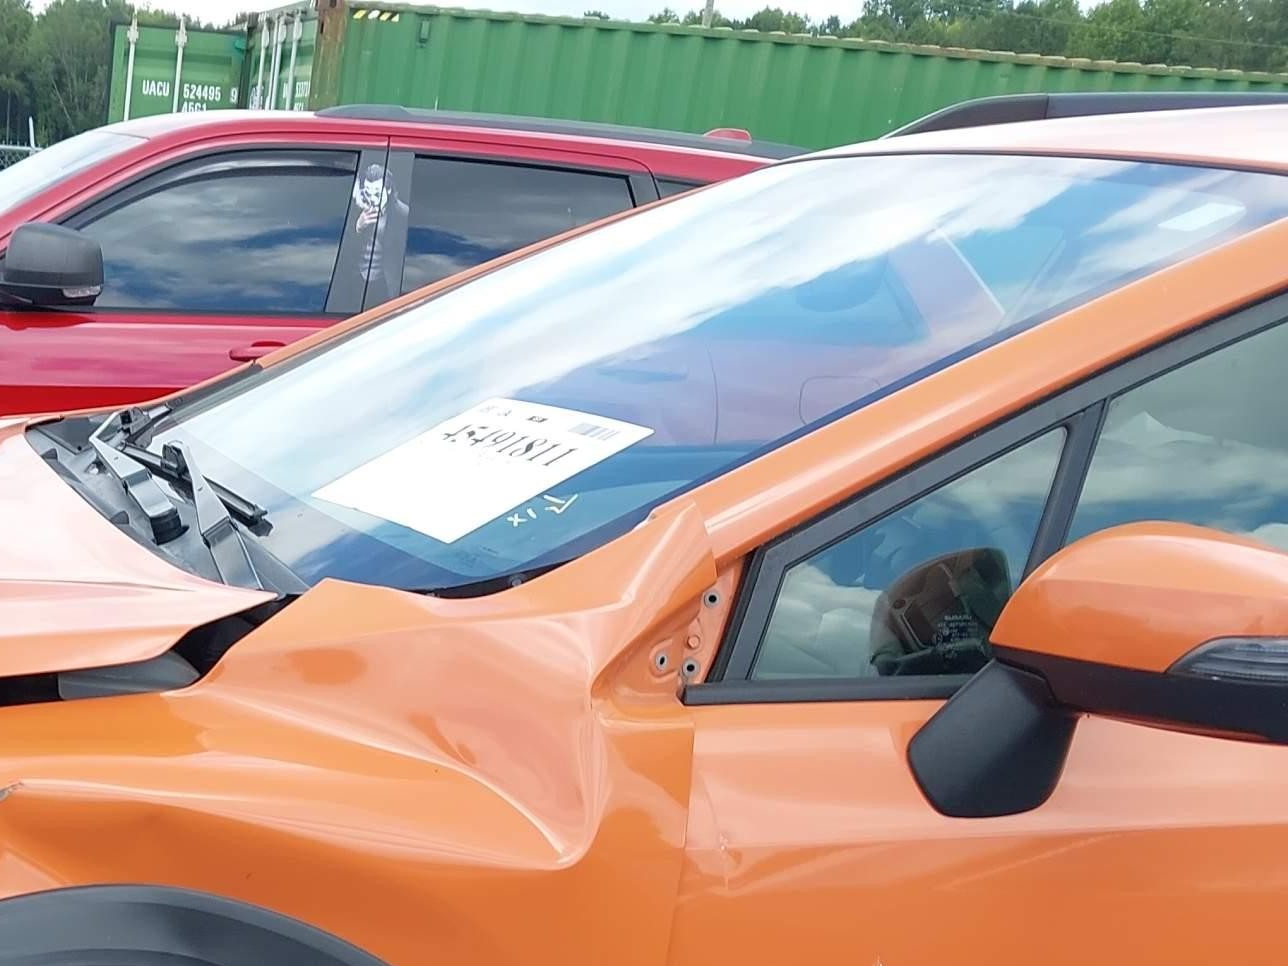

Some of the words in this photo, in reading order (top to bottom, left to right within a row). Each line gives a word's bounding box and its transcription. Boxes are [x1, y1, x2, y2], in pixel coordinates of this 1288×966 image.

[142, 79, 170, 97] UACU
[230, 87, 238, 104] 9
[442, 424, 578, 466] 45491811
